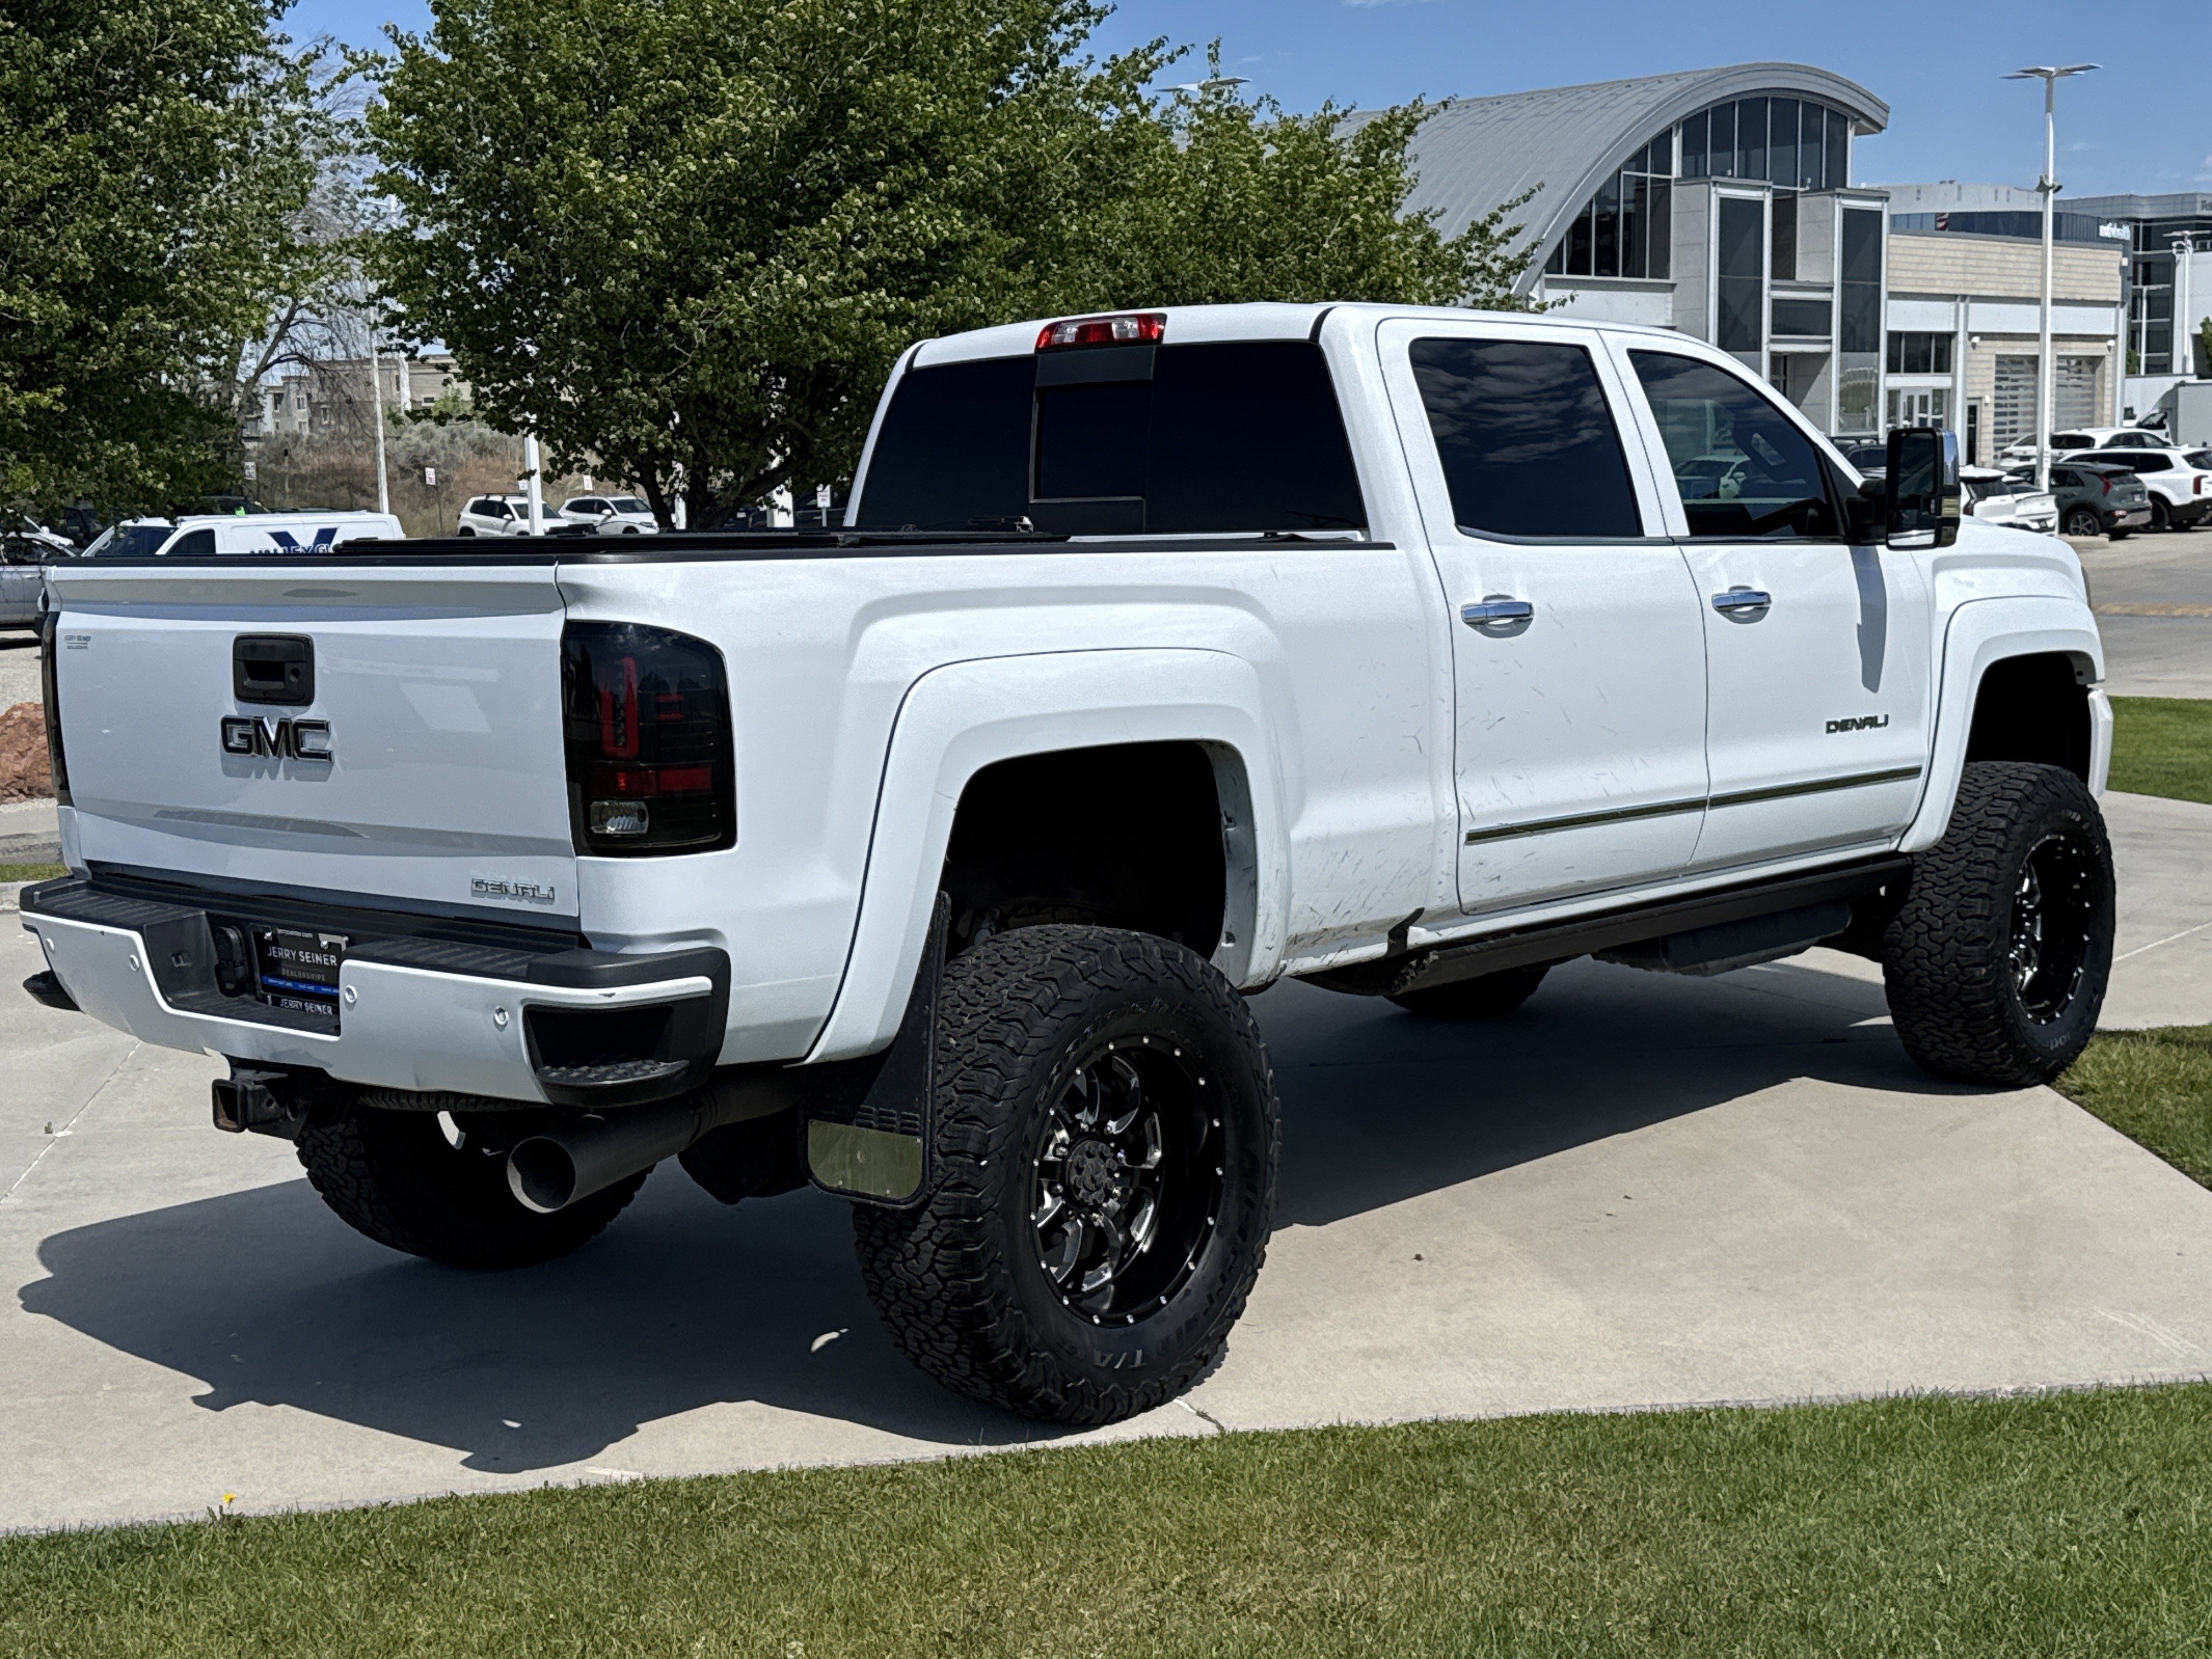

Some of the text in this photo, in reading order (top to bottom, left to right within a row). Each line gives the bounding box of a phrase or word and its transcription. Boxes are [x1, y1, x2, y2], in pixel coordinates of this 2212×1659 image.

[1826, 714, 1889, 734] DENALI
[221, 715, 334, 763] GMC
[471, 878, 555, 900] DENALI
[268, 946, 338, 967] JERRY SEINER
[280, 998, 333, 1015] JERRY SEINER
